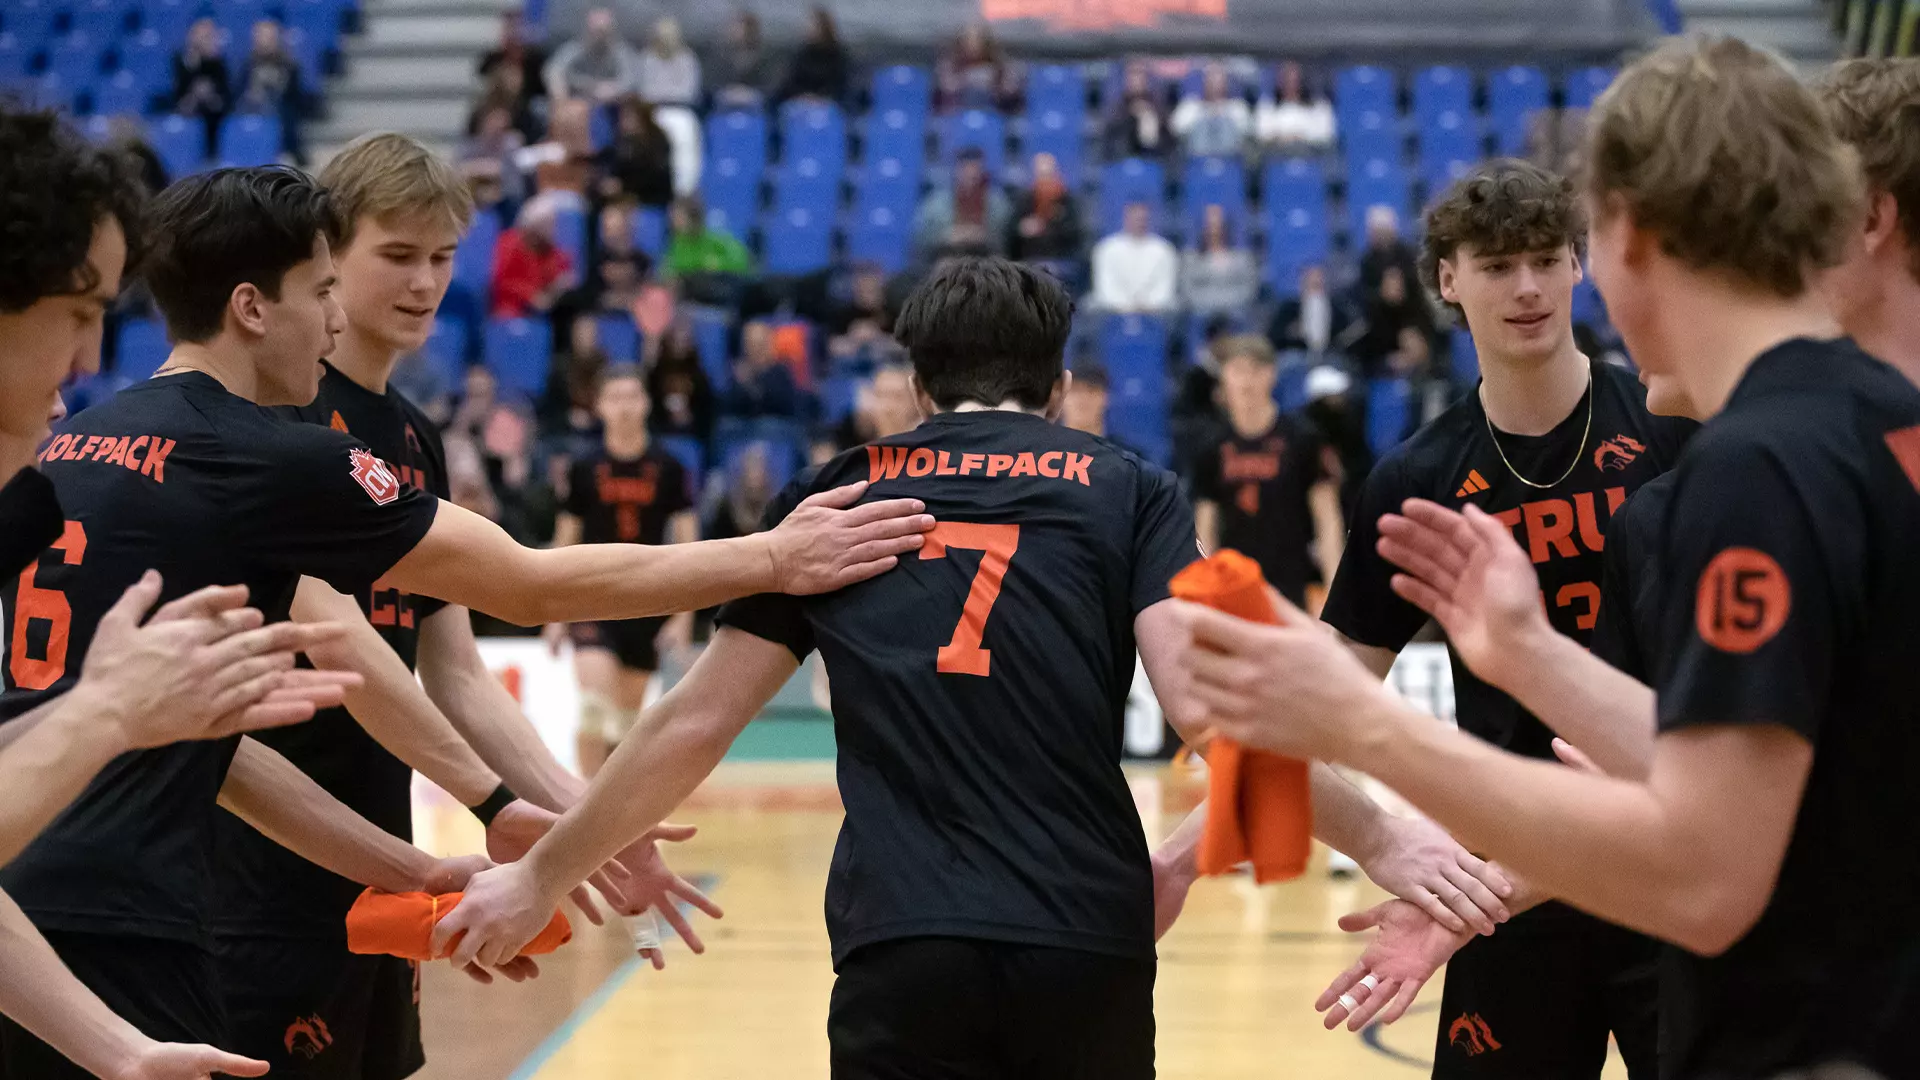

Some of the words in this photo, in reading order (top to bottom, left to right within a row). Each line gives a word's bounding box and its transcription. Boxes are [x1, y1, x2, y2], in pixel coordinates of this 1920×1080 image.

[38, 433, 177, 484] OLFPACK
[866, 445, 1094, 486] WOLFPACK
[10, 520, 88, 690] 6
[919, 521, 1020, 677] 7
[1713, 570, 1767, 632] 15
